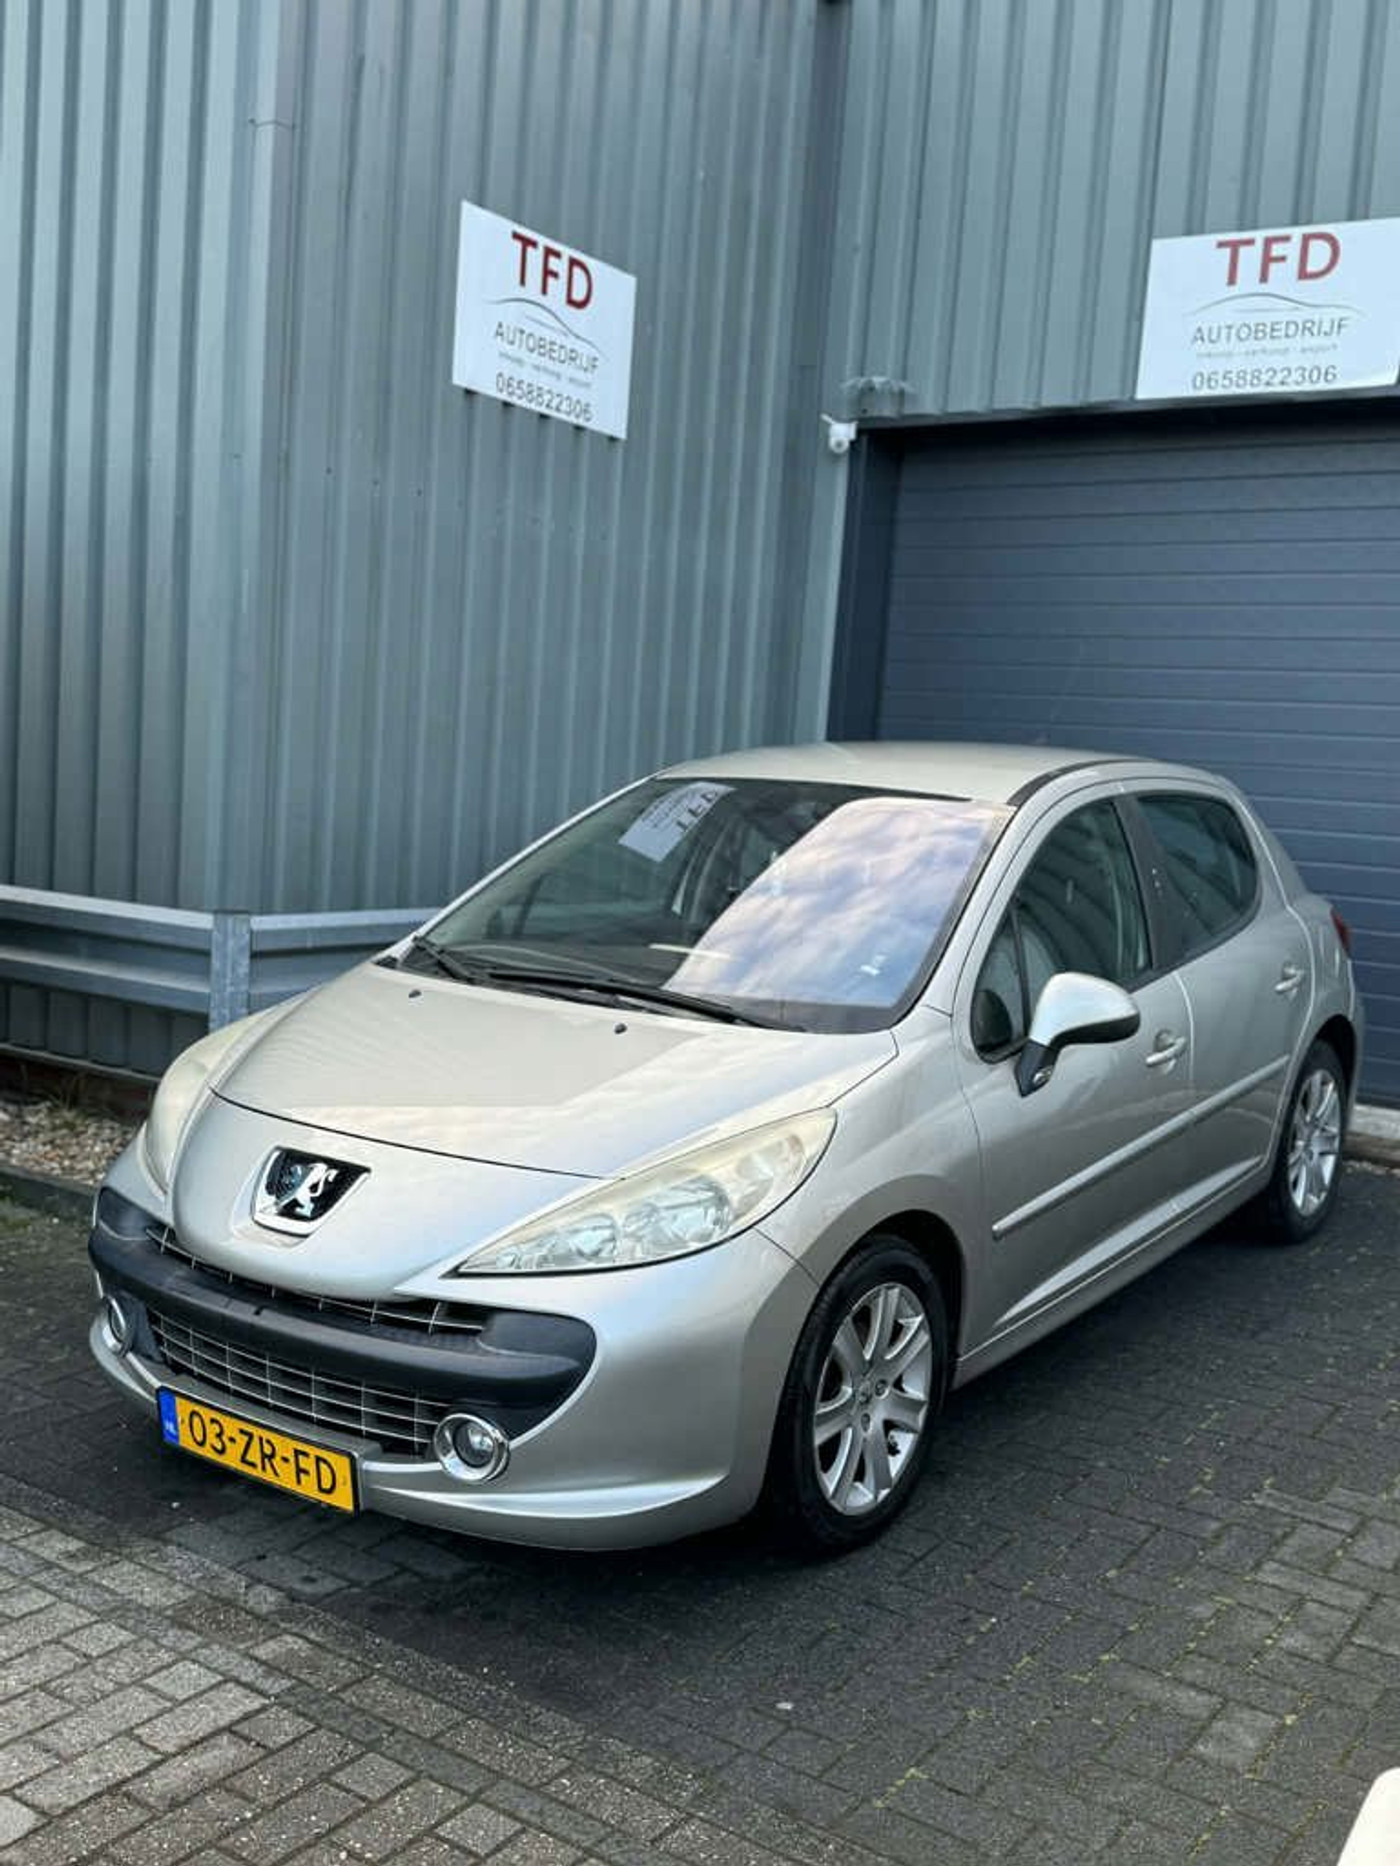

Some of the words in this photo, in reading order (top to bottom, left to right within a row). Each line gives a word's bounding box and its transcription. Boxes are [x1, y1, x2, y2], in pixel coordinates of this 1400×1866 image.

[512, 230, 593, 310] TFD
[1216, 231, 1341, 287] TFD
[495, 321, 599, 374] AUTOBEDRIJF
[1191, 317, 1351, 345] AUTOBEDRIJF
[1192, 364, 1338, 391] 0658822306
[189, 1410, 336, 1494] 03-ZR-FD
